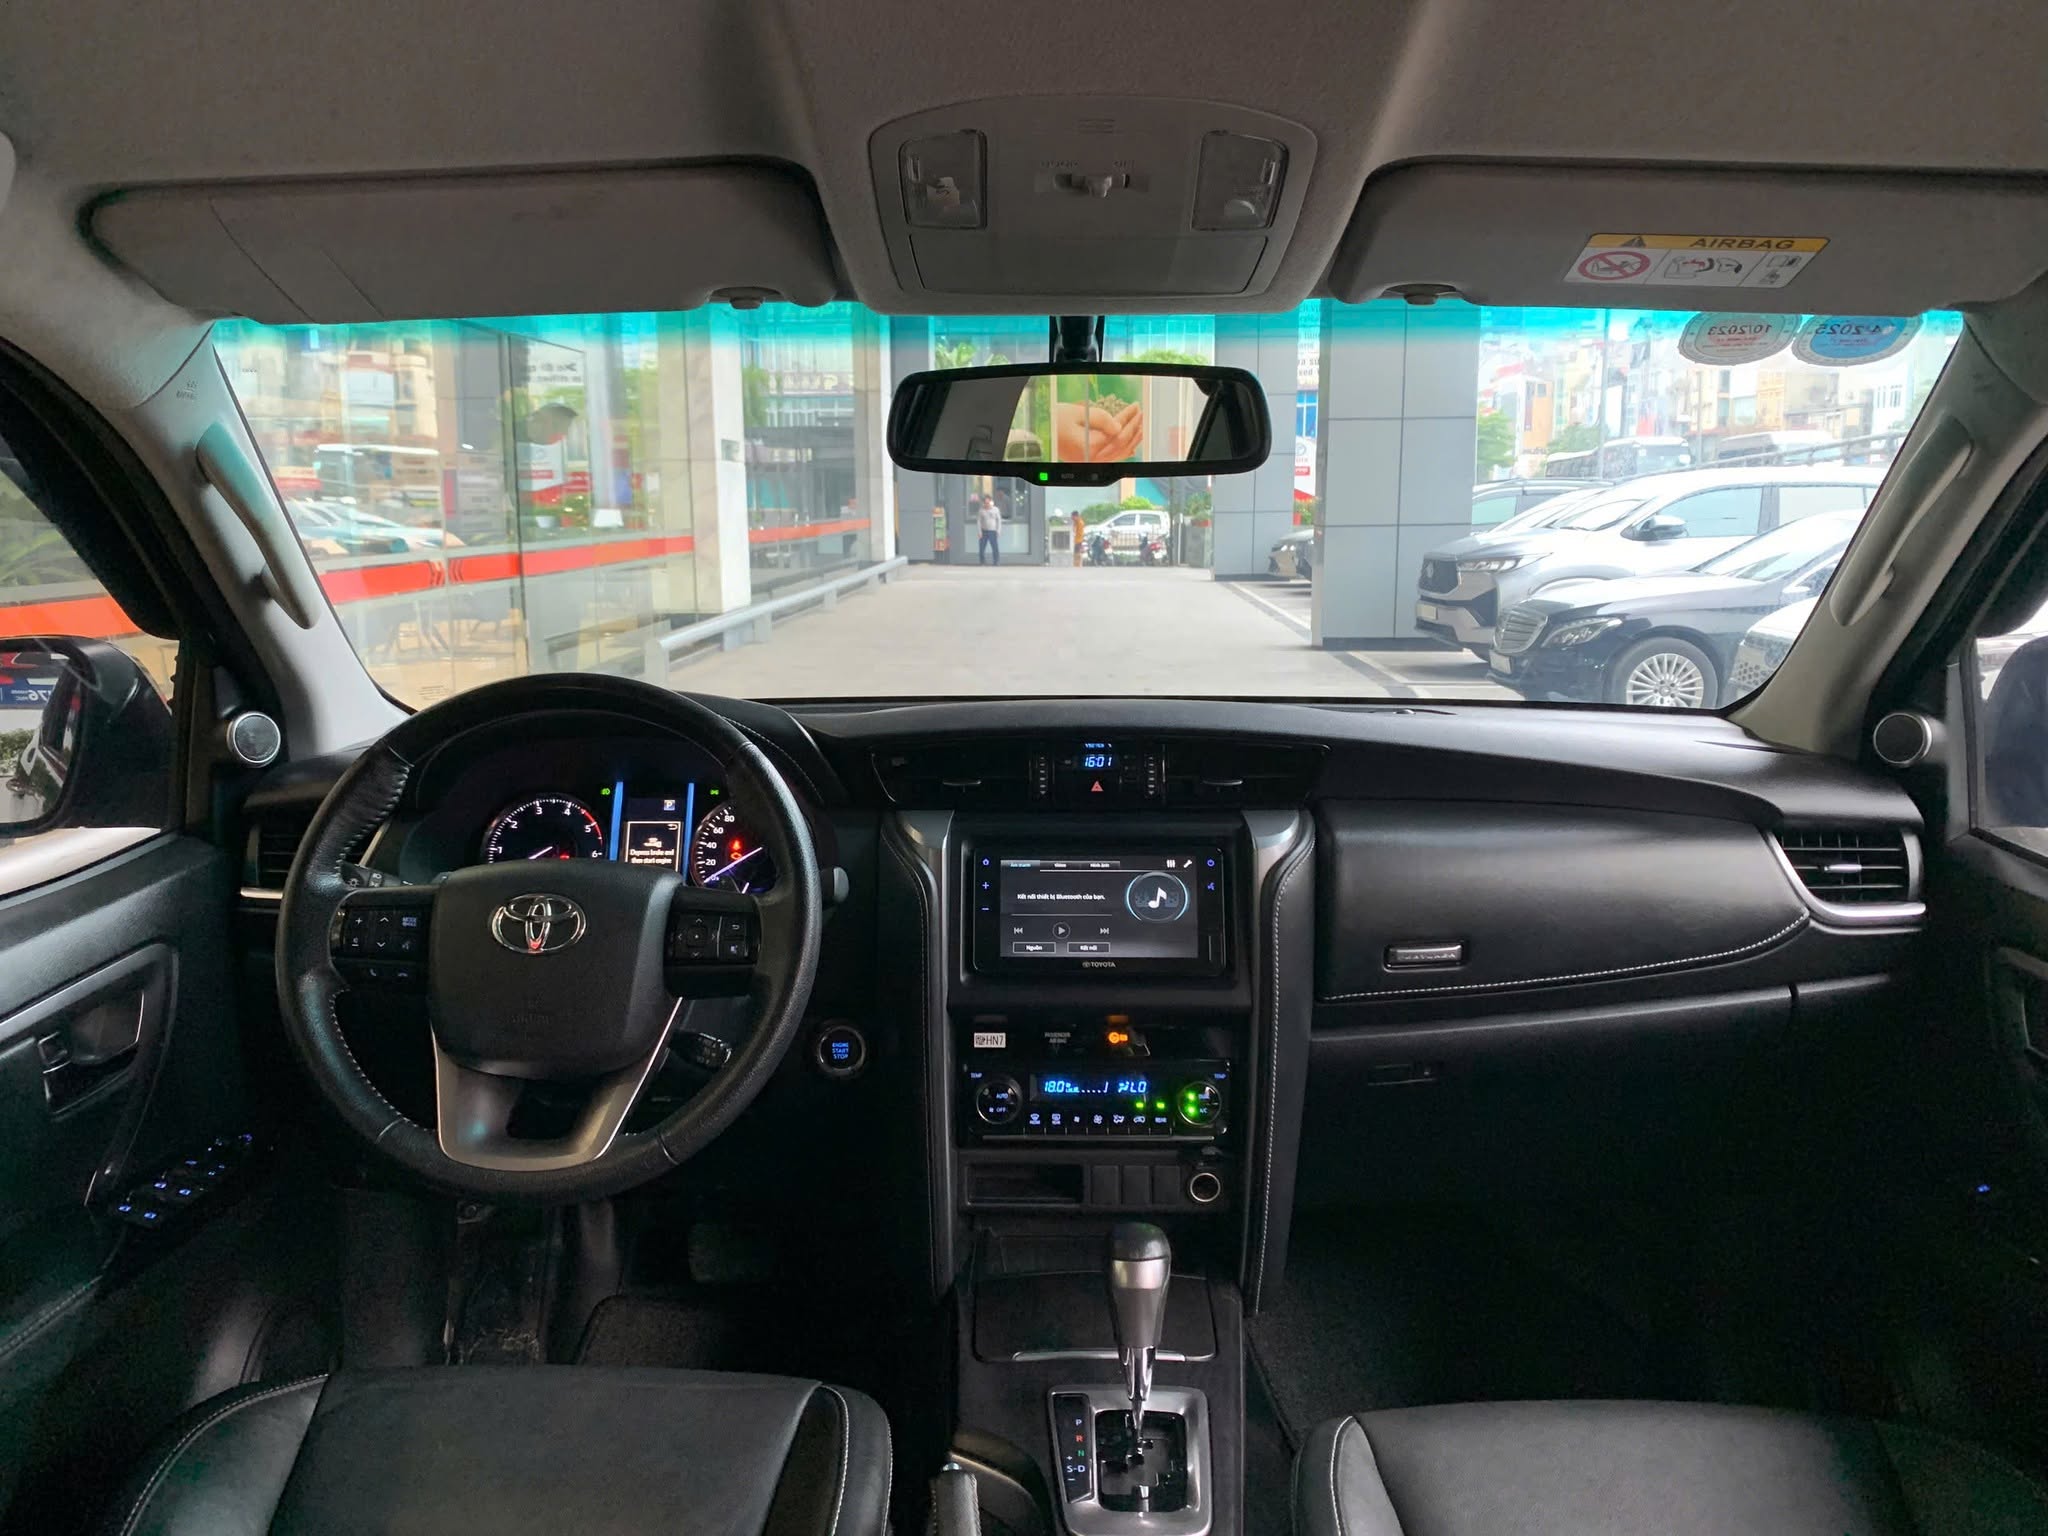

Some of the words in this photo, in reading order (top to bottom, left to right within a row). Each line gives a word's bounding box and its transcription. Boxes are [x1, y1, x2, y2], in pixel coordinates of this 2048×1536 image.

[1689, 238, 1794, 250] AIRBAG
[536, 806, 543, 815] 3
[563, 808, 571, 816] 4
[724, 815, 735, 823] 80
[510, 820, 518, 829] 2
[584, 824, 592, 833] 5
[591, 850, 598, 858] 6
[705, 858, 716, 866] 20
[986, 1035, 1004, 1046] HN7
[1130, 1081, 1147, 1093] LO
[1075, 1418, 1082, 1426] P
